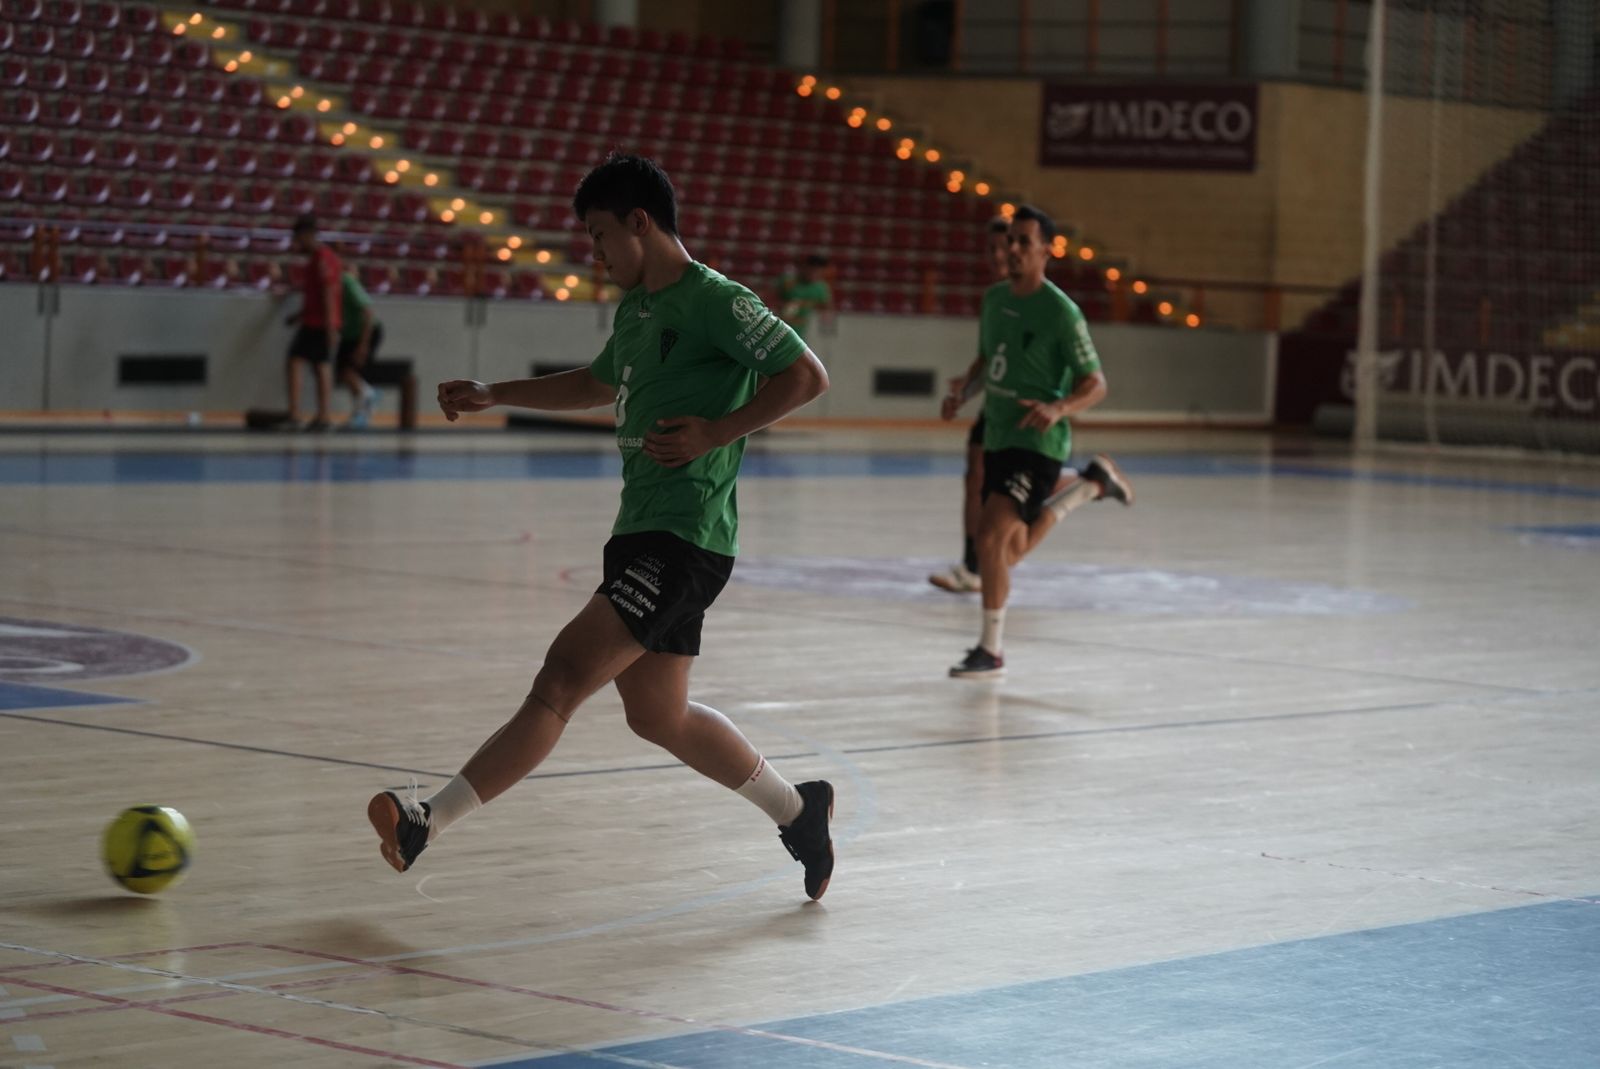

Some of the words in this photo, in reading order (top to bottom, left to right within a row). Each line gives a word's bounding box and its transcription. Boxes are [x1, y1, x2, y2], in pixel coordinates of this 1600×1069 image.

[1092, 100, 1252, 142] IMDECO
[1409, 350, 1600, 411] IMDEC
[611, 592, 644, 618] Kappa
